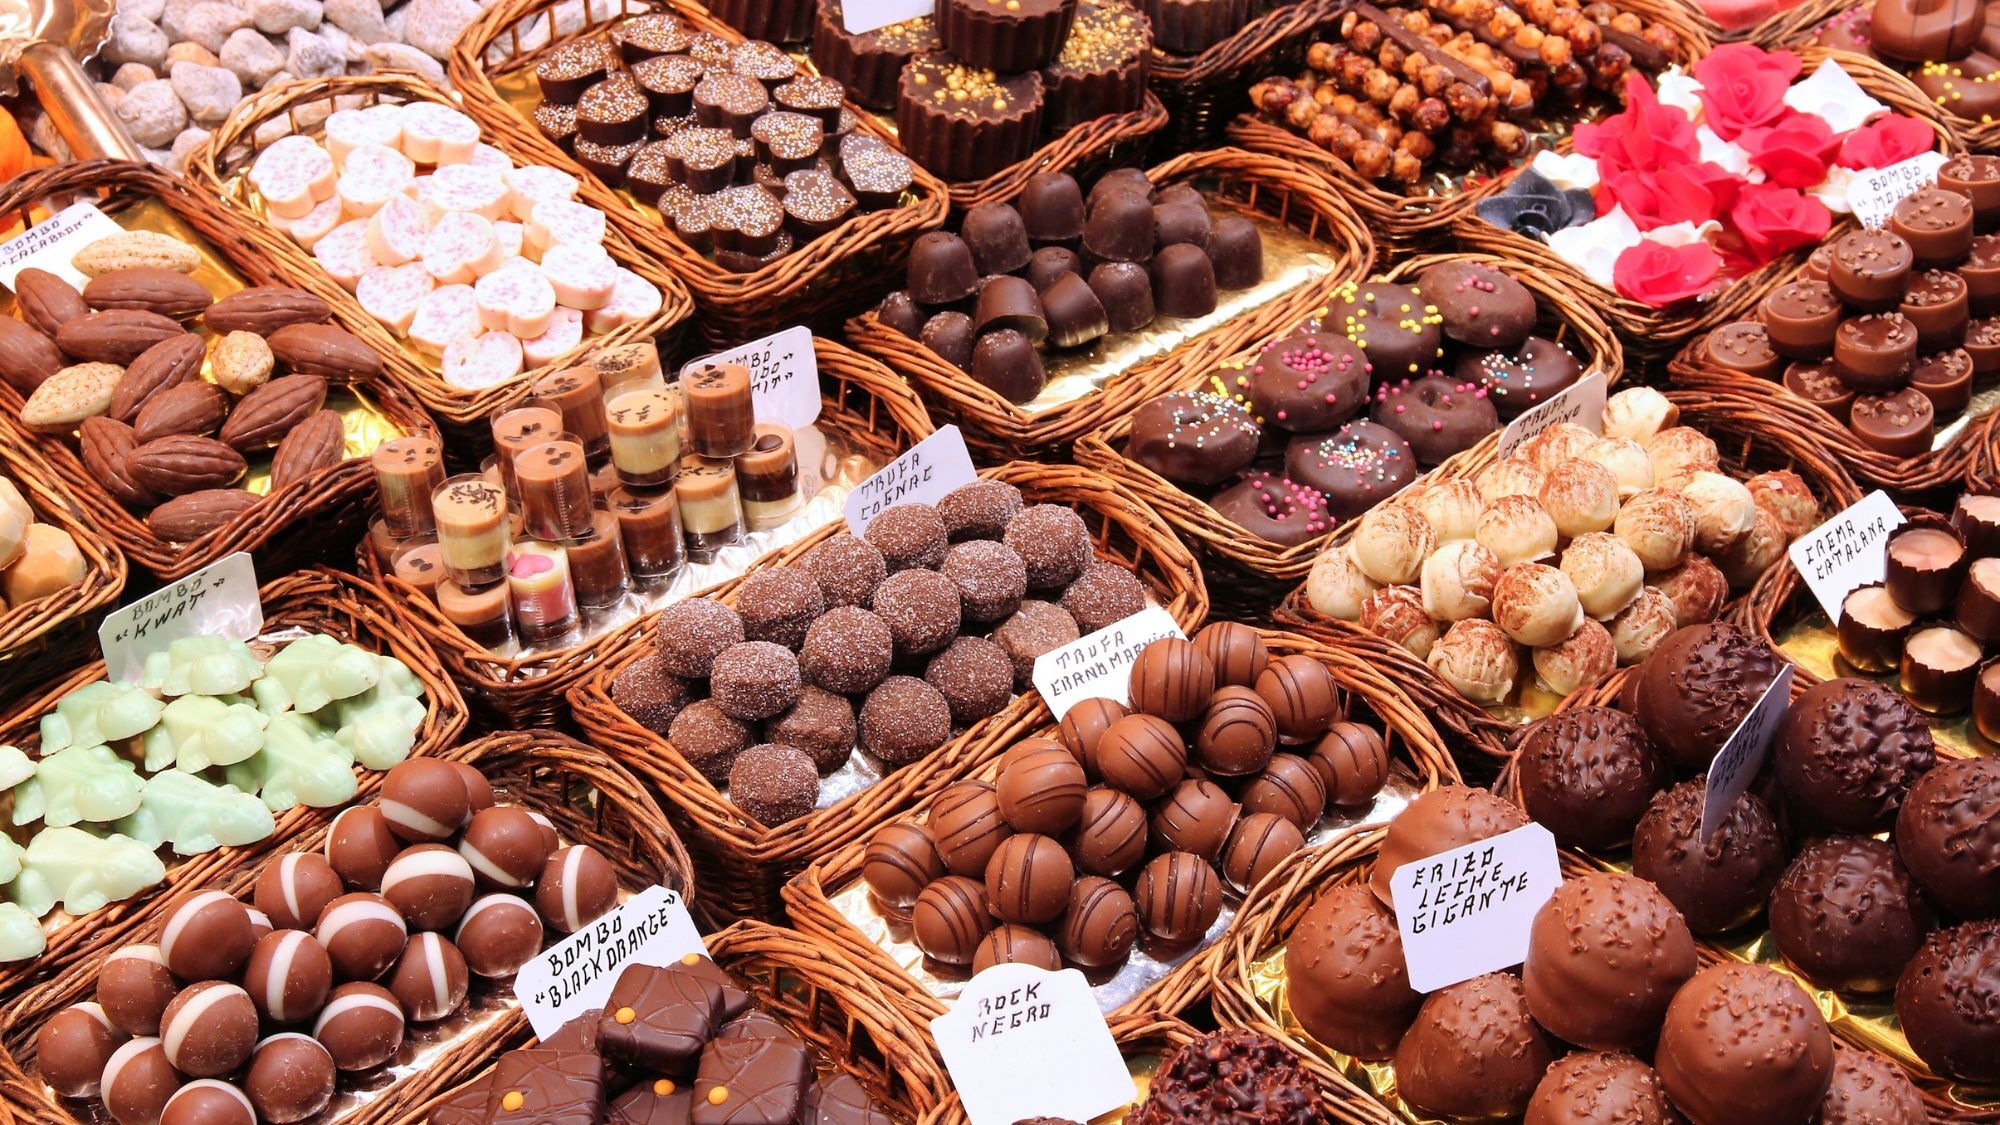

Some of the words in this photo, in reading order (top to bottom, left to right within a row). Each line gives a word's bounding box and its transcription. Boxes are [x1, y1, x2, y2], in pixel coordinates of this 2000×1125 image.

[2, 213, 62, 256] BOMBÓ
[1519, 394, 1568, 433] TRUFA
[860, 452, 920, 500] TRUFA
[860, 465, 933, 521] COGNAC
[1805, 519, 1856, 566] CREMA
[1816, 516, 1887, 581] CATALANA
[132, 570, 208, 622] BOMBÓ
[1055, 629, 1126, 671] TRUFA
[1412, 846, 1495, 889] ERIZO
[1418, 862, 1504, 910] LECHE
[1412, 871, 1529, 935] GIGANTE
[548, 905, 625, 978] BOMBÓ
[972, 1003, 1051, 1043] NEGRO
[978, 981, 1042, 1018] ROCK
